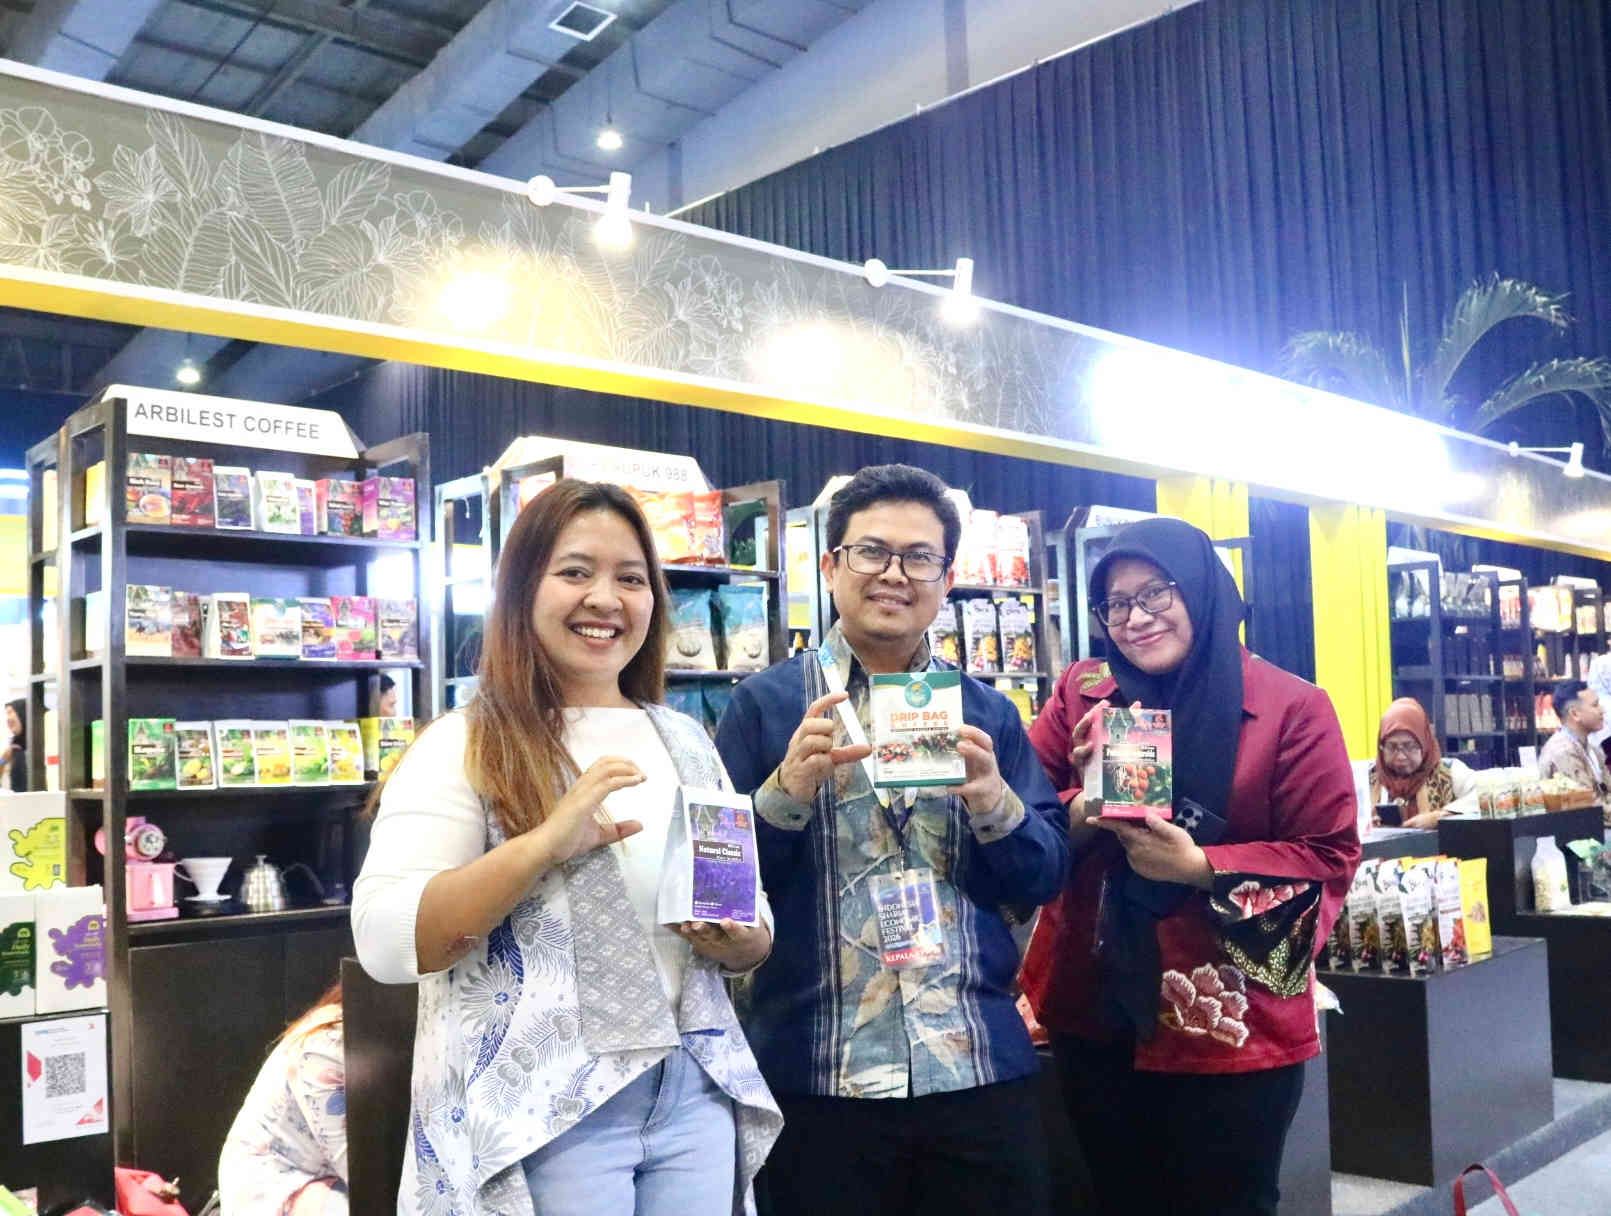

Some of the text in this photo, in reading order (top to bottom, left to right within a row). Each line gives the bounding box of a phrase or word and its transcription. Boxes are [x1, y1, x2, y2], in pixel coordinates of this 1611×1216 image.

[134, 402, 320, 439] ARBILEST COFFEE
[890, 710, 949, 721] DRIP BAG
